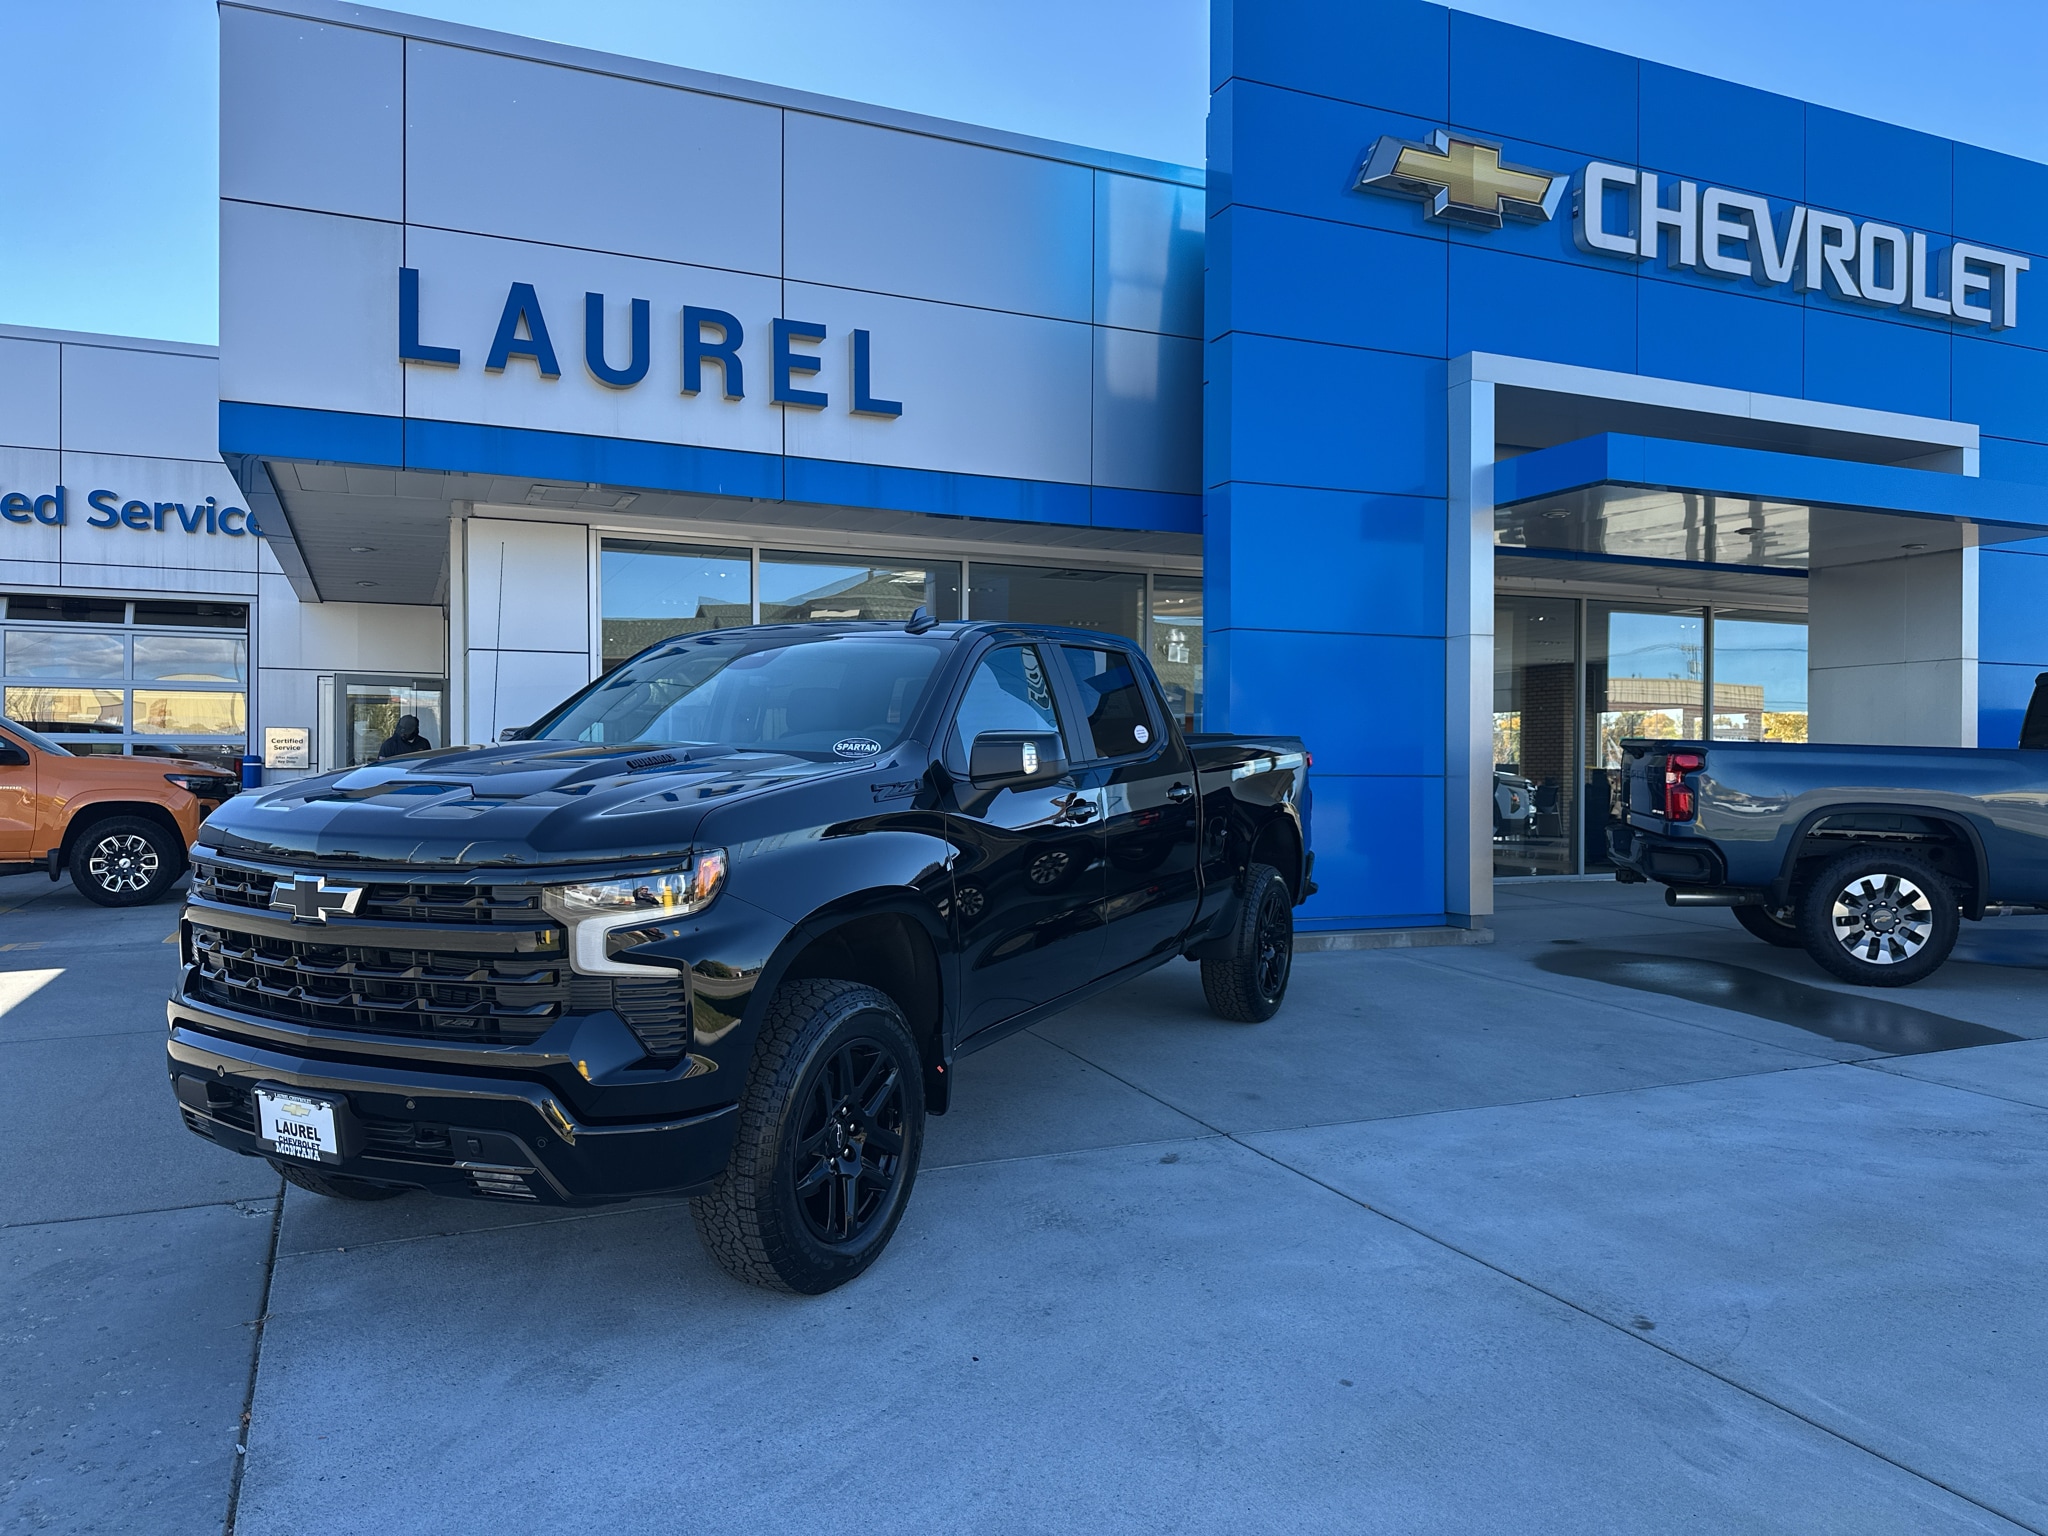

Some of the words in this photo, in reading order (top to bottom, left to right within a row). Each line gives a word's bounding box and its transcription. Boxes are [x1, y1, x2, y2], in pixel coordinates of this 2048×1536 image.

[1573, 160, 2031, 331] CHEVROLET
[399, 266, 904, 420] LAUREL
[836, 743, 878, 752] SPARTAN
[275, 1119, 321, 1142] LAUREL
[274, 1141, 321, 1161] MONTANA
[278, 1135, 321, 1151] CHEVROLET
